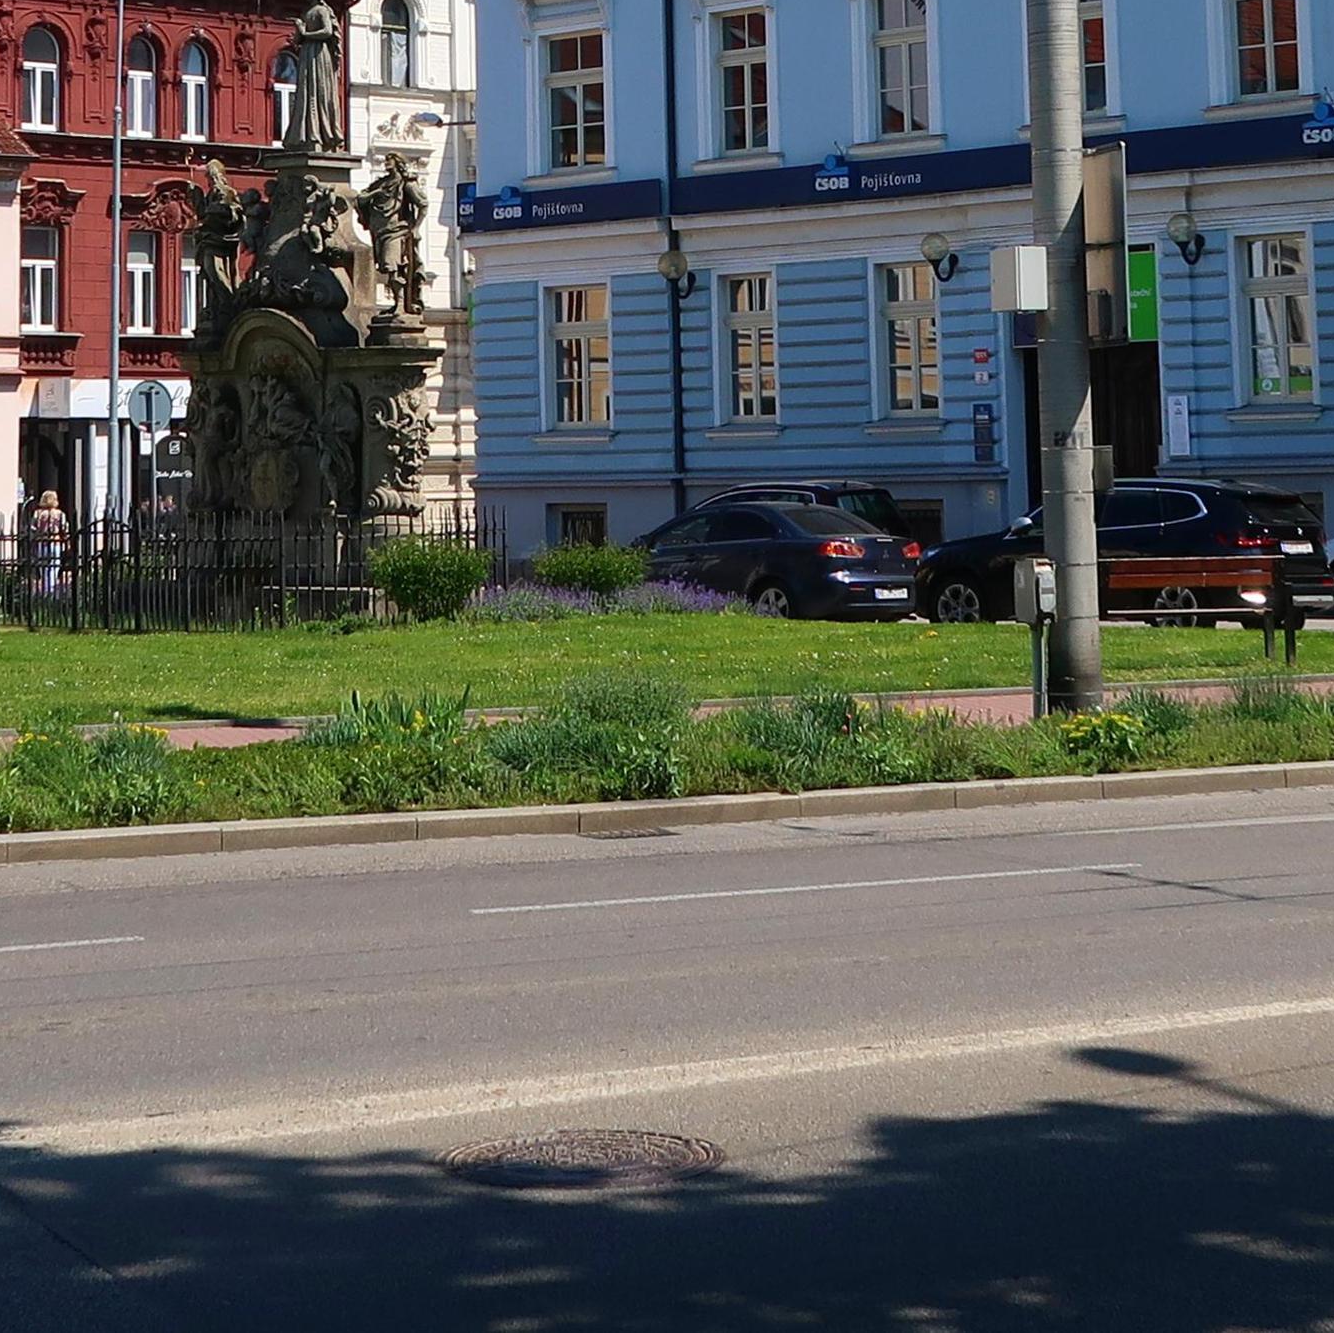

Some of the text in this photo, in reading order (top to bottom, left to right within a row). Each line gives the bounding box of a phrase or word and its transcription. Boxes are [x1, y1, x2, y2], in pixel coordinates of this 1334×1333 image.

[815, 172, 922, 192] ČSOB Pojišťovna
[493, 203, 584, 220] ČSOB Pojišťovna
